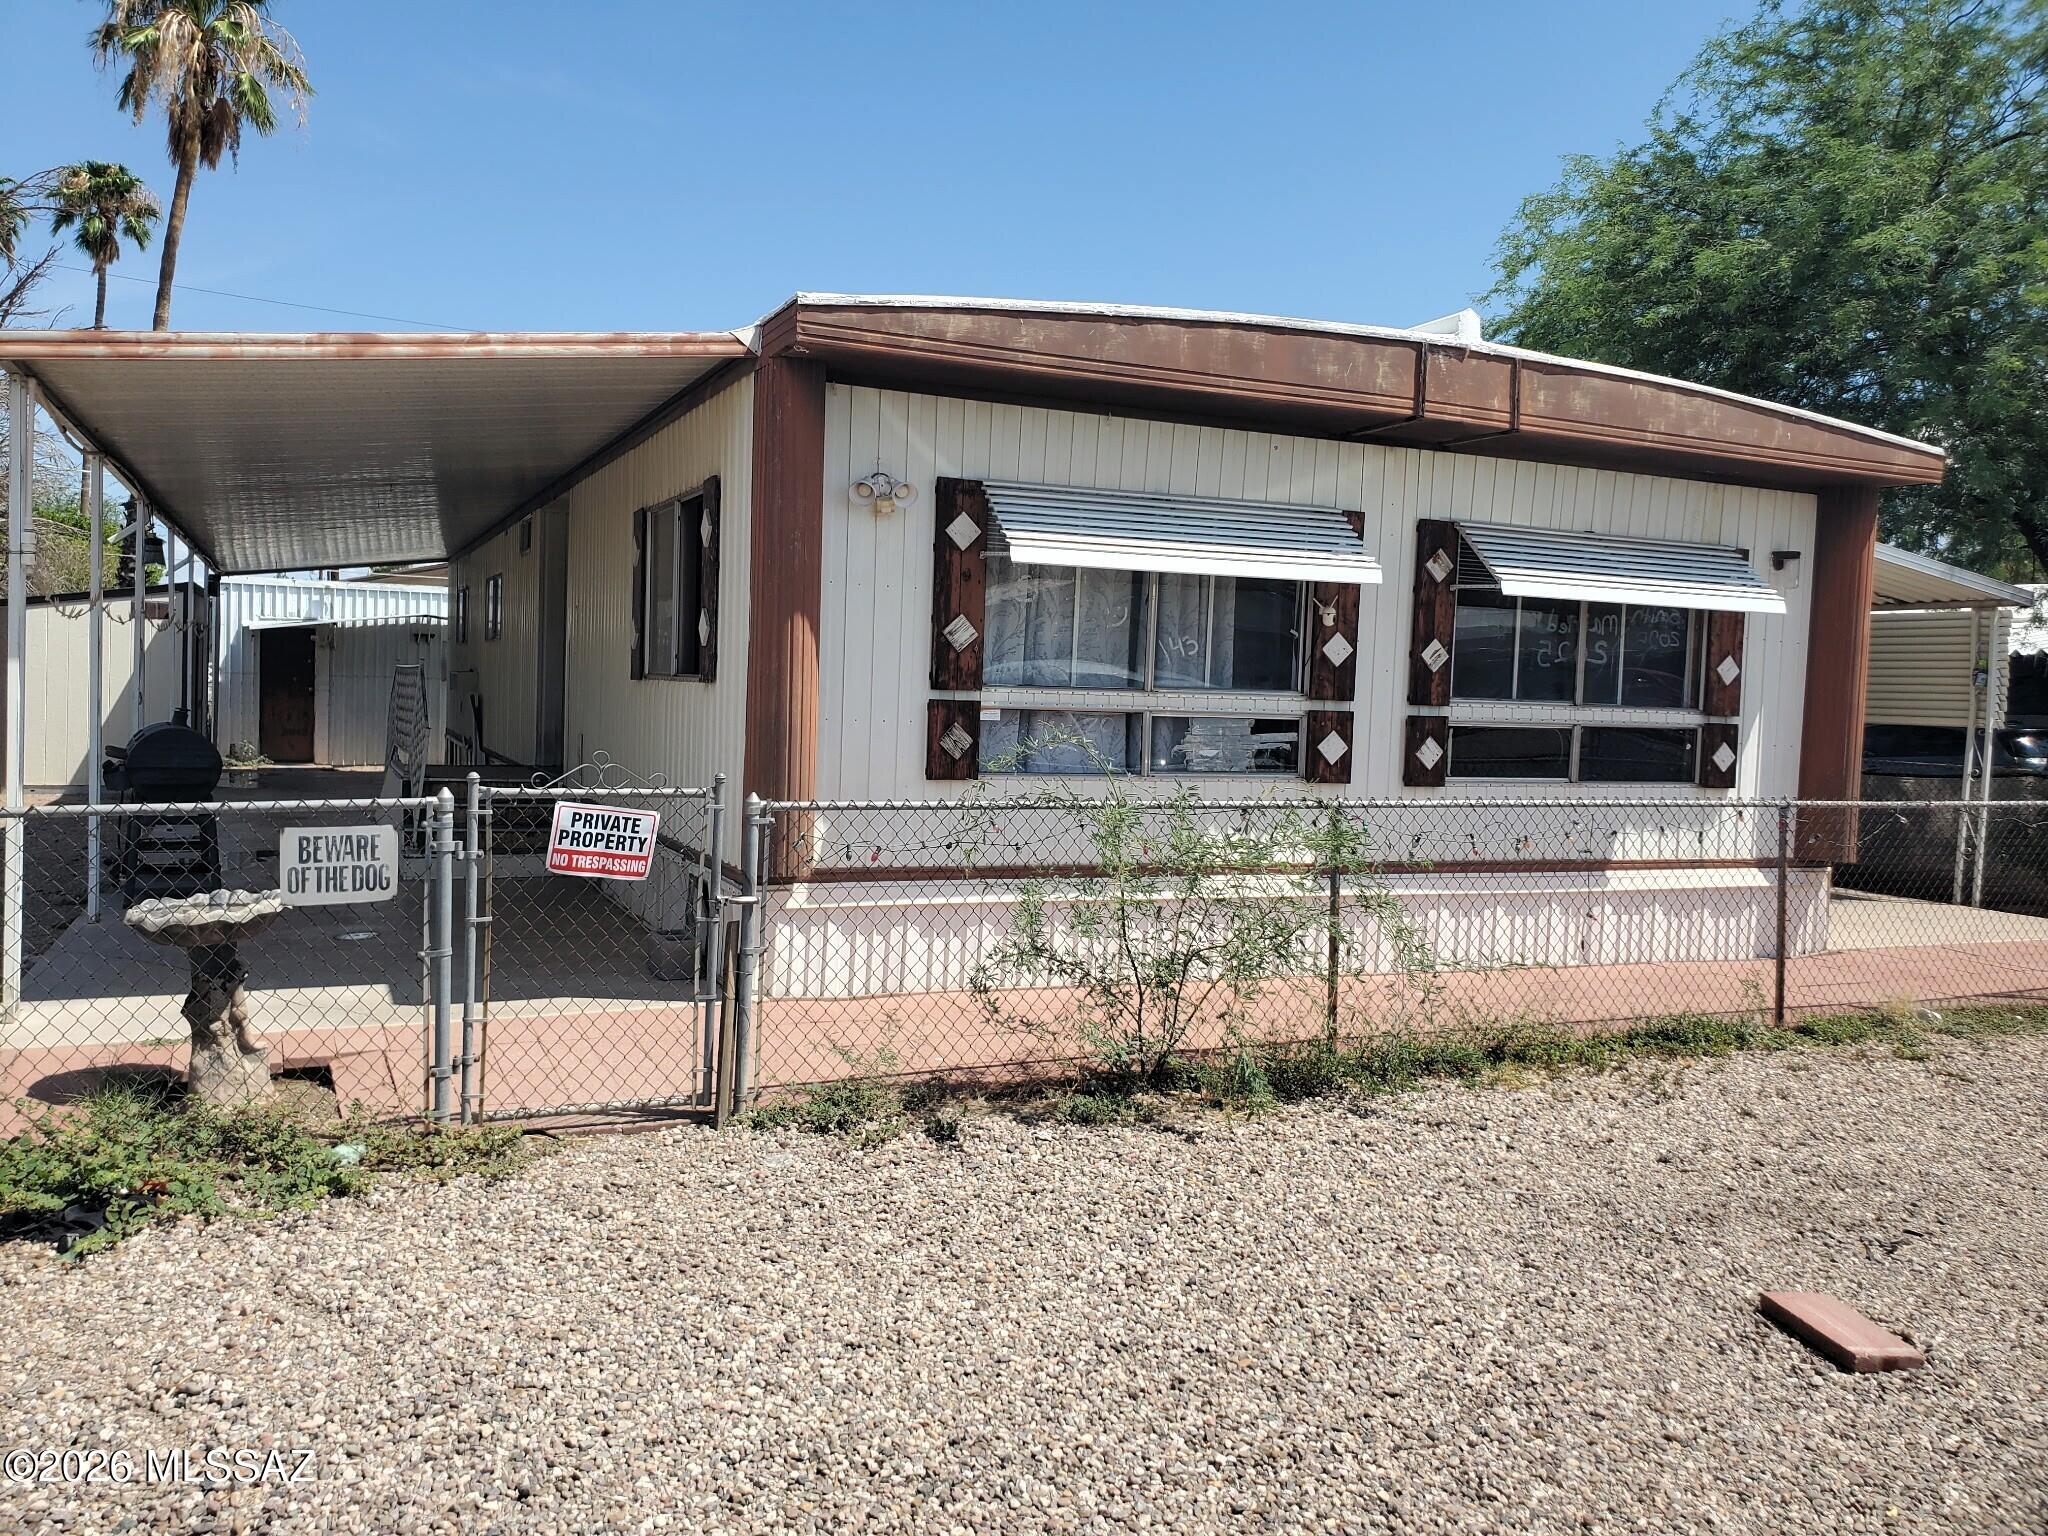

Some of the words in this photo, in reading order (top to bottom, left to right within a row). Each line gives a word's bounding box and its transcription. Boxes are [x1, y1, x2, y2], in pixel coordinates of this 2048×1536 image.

[571, 812, 642, 834] PRIVATE
[298, 834, 381, 864] BEWARE
[557, 829, 648, 852] PROPERTY
[551, 852, 568, 866] NO
[570, 855, 646, 873] TRESPASSING
[287, 866, 311, 895] OF
[315, 865, 349, 893] THE
[352, 863, 391, 892] DOG
